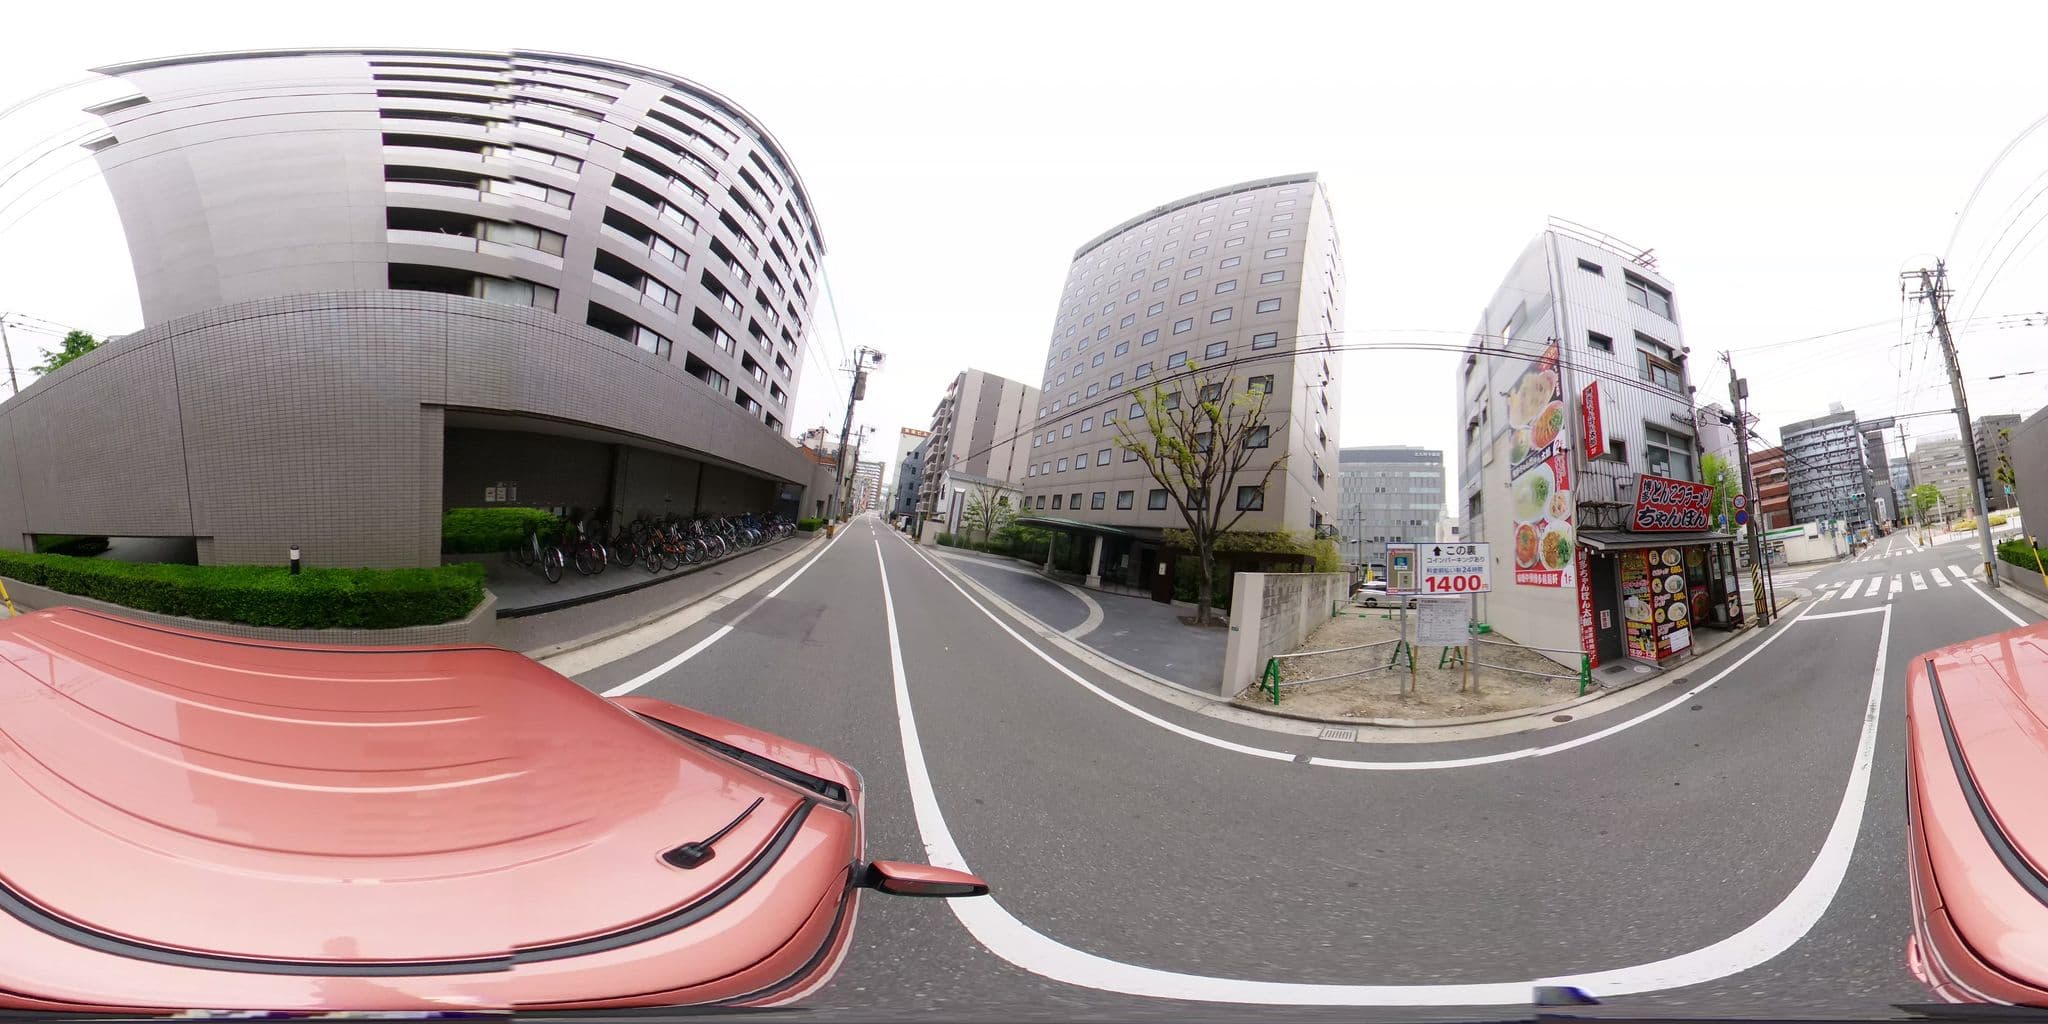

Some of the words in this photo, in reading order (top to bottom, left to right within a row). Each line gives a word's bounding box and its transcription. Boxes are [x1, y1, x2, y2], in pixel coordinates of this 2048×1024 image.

[1638, 505, 1708, 528] ちゃんぽん
[1446, 545, 1476, 556] この裏
